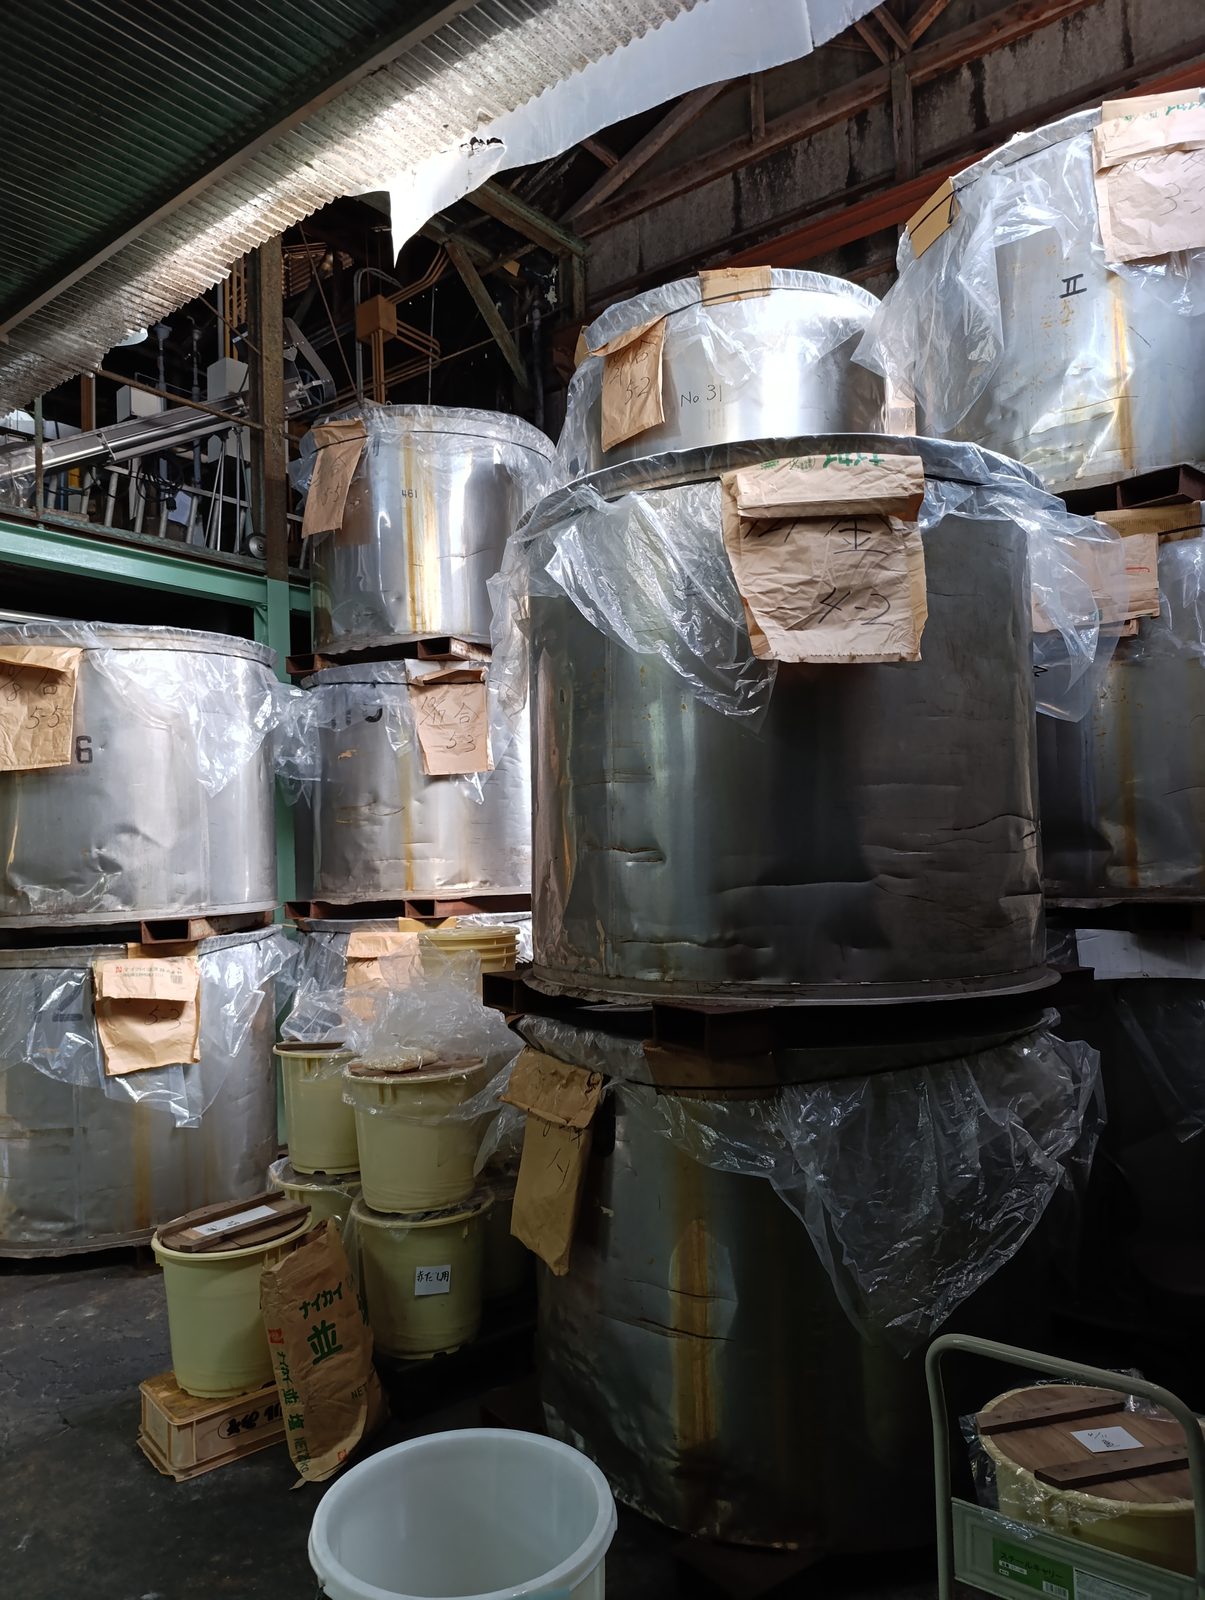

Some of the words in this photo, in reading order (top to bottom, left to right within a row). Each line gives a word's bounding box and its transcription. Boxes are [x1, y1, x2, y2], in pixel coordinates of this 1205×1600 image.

[680, 391, 700, 408] No
[706, 384, 722, 402] 31
[401, 489, 418, 499] 461
[818, 586, 895, 627] 4-2
[25, 705, 65, 730] 5-5
[75, 735, 93, 764] 6
[299, 1281, 343, 1320] ナイカイ
[306, 1319, 344, 1366] 並
